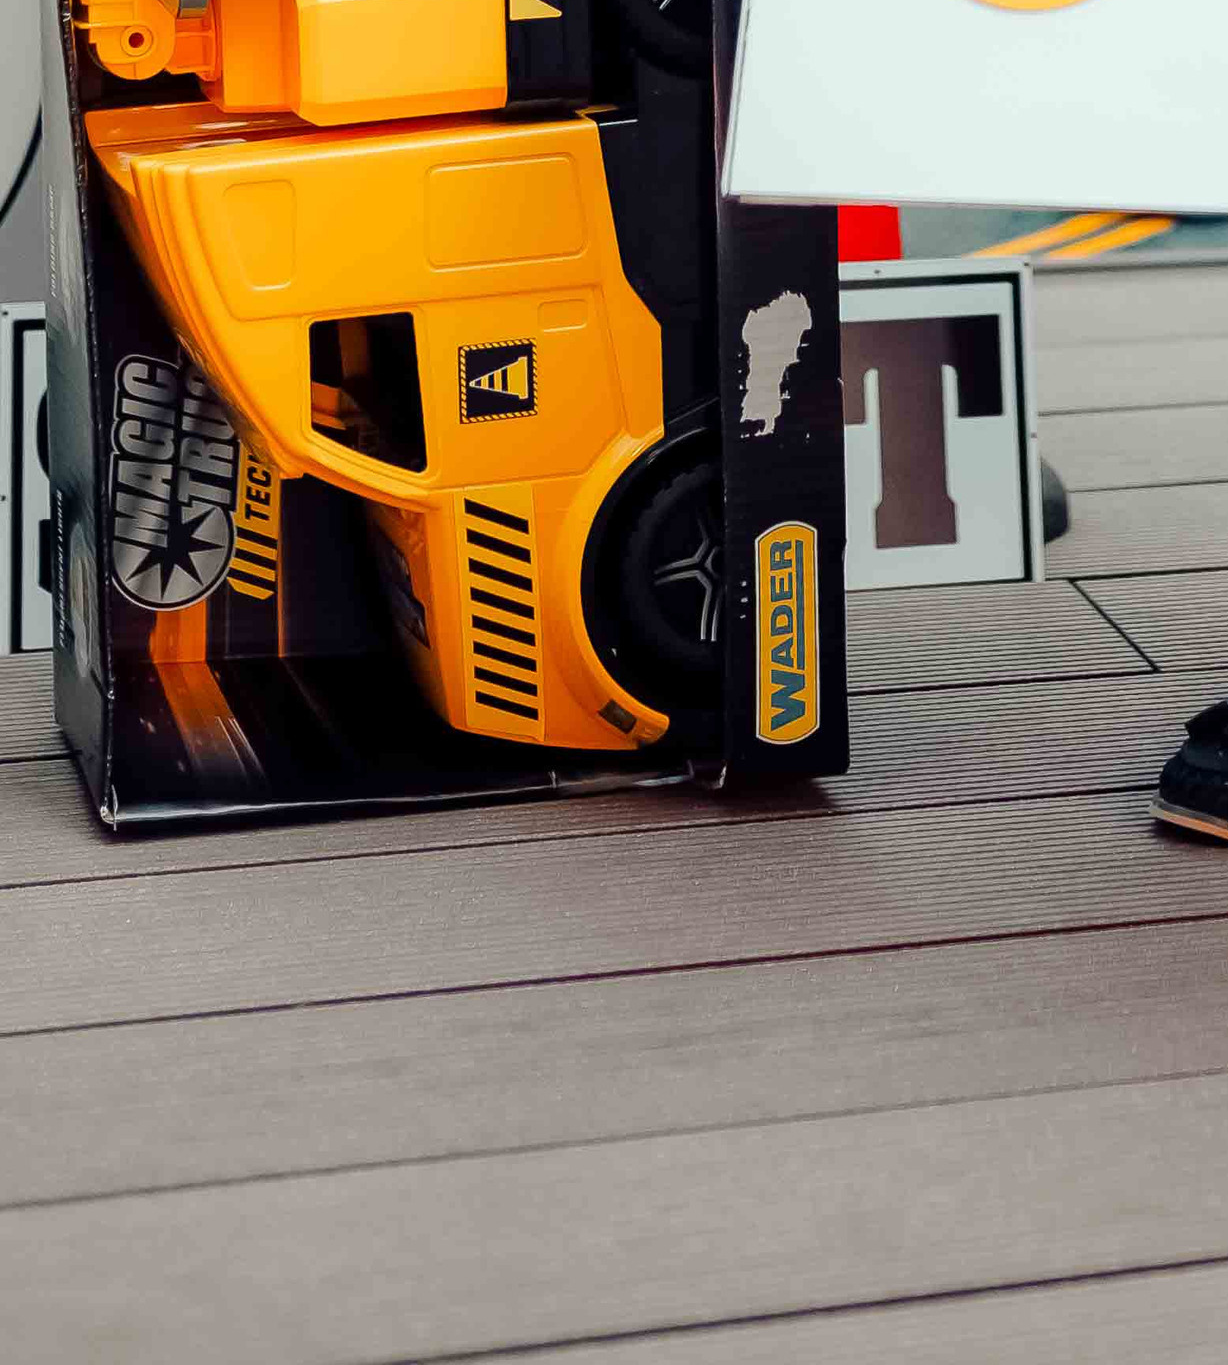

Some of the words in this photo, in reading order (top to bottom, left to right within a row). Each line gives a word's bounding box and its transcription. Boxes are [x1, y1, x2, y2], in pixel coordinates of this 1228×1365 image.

[113, 361, 177, 548] MAGIC
[841, 315, 1004, 549] T
[769, 540, 809, 732] WADER
